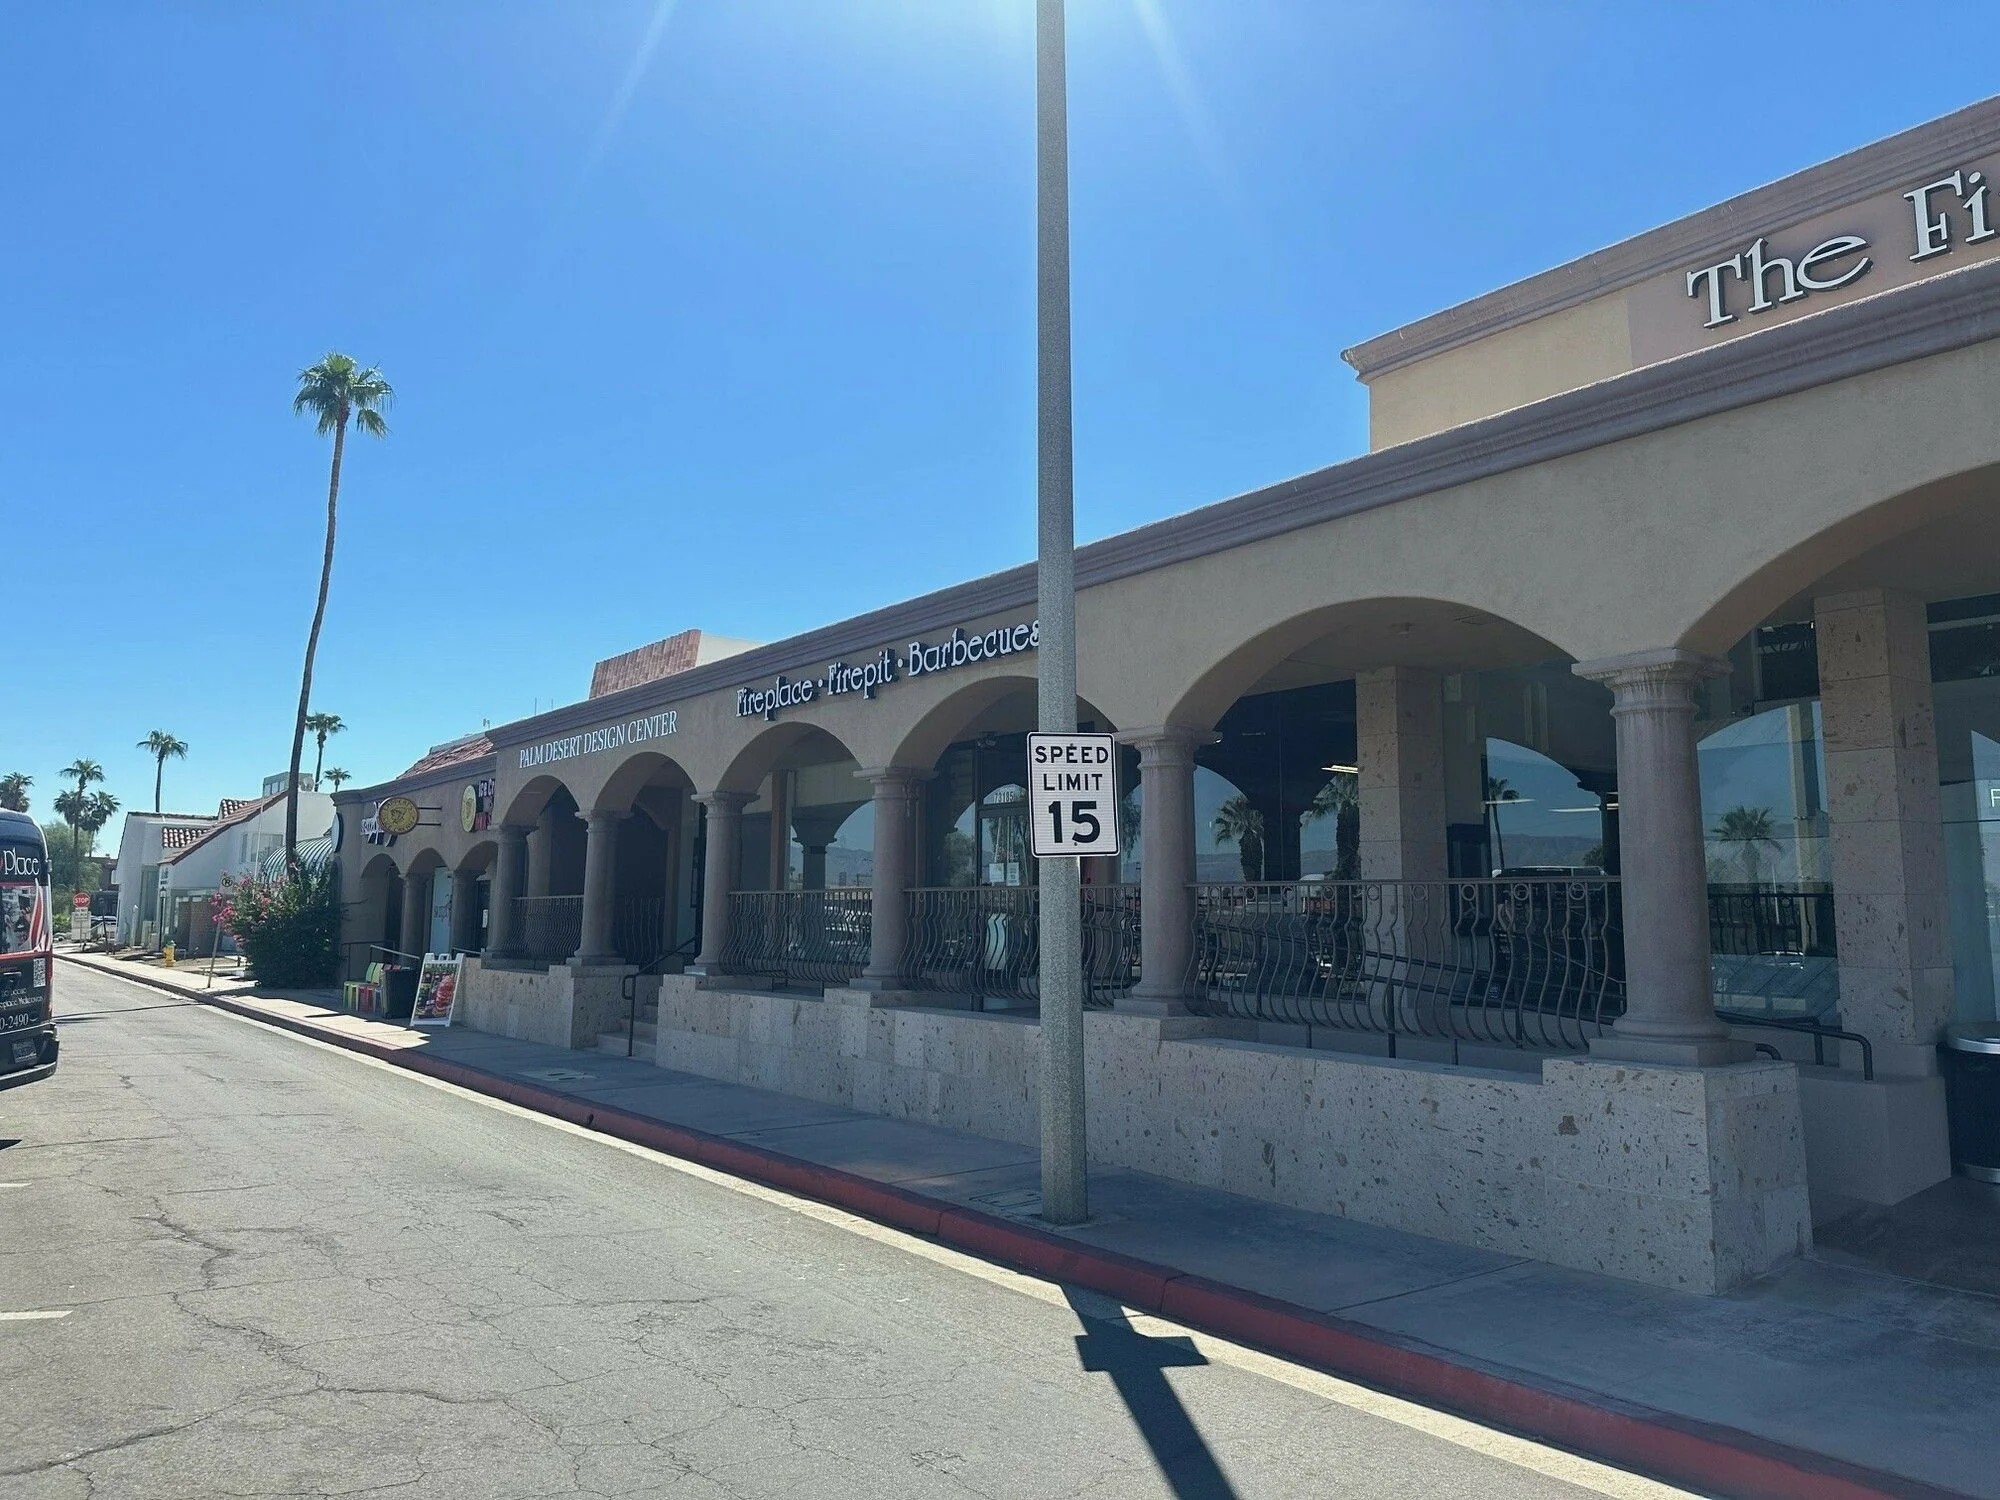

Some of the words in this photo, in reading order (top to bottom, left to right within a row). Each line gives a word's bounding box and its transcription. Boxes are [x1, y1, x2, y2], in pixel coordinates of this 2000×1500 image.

[1686, 237, 1870, 328] The
[736, 676, 813, 721] Fireplace
[827, 650, 893, 699] Firepit
[908, 620, 1038, 677] Barbecues
[519, 744, 544, 769] PALM
[545, 735, 582, 763] DESERT
[584, 724, 626, 754] DESIGN
[628, 710, 678, 744] CENTER
[1034, 745, 1109, 764] SPEED
[1043, 773, 1103, 791] LIMIT
[1048, 800, 1101, 843] 15
[3, 847, 40, 875] Place
